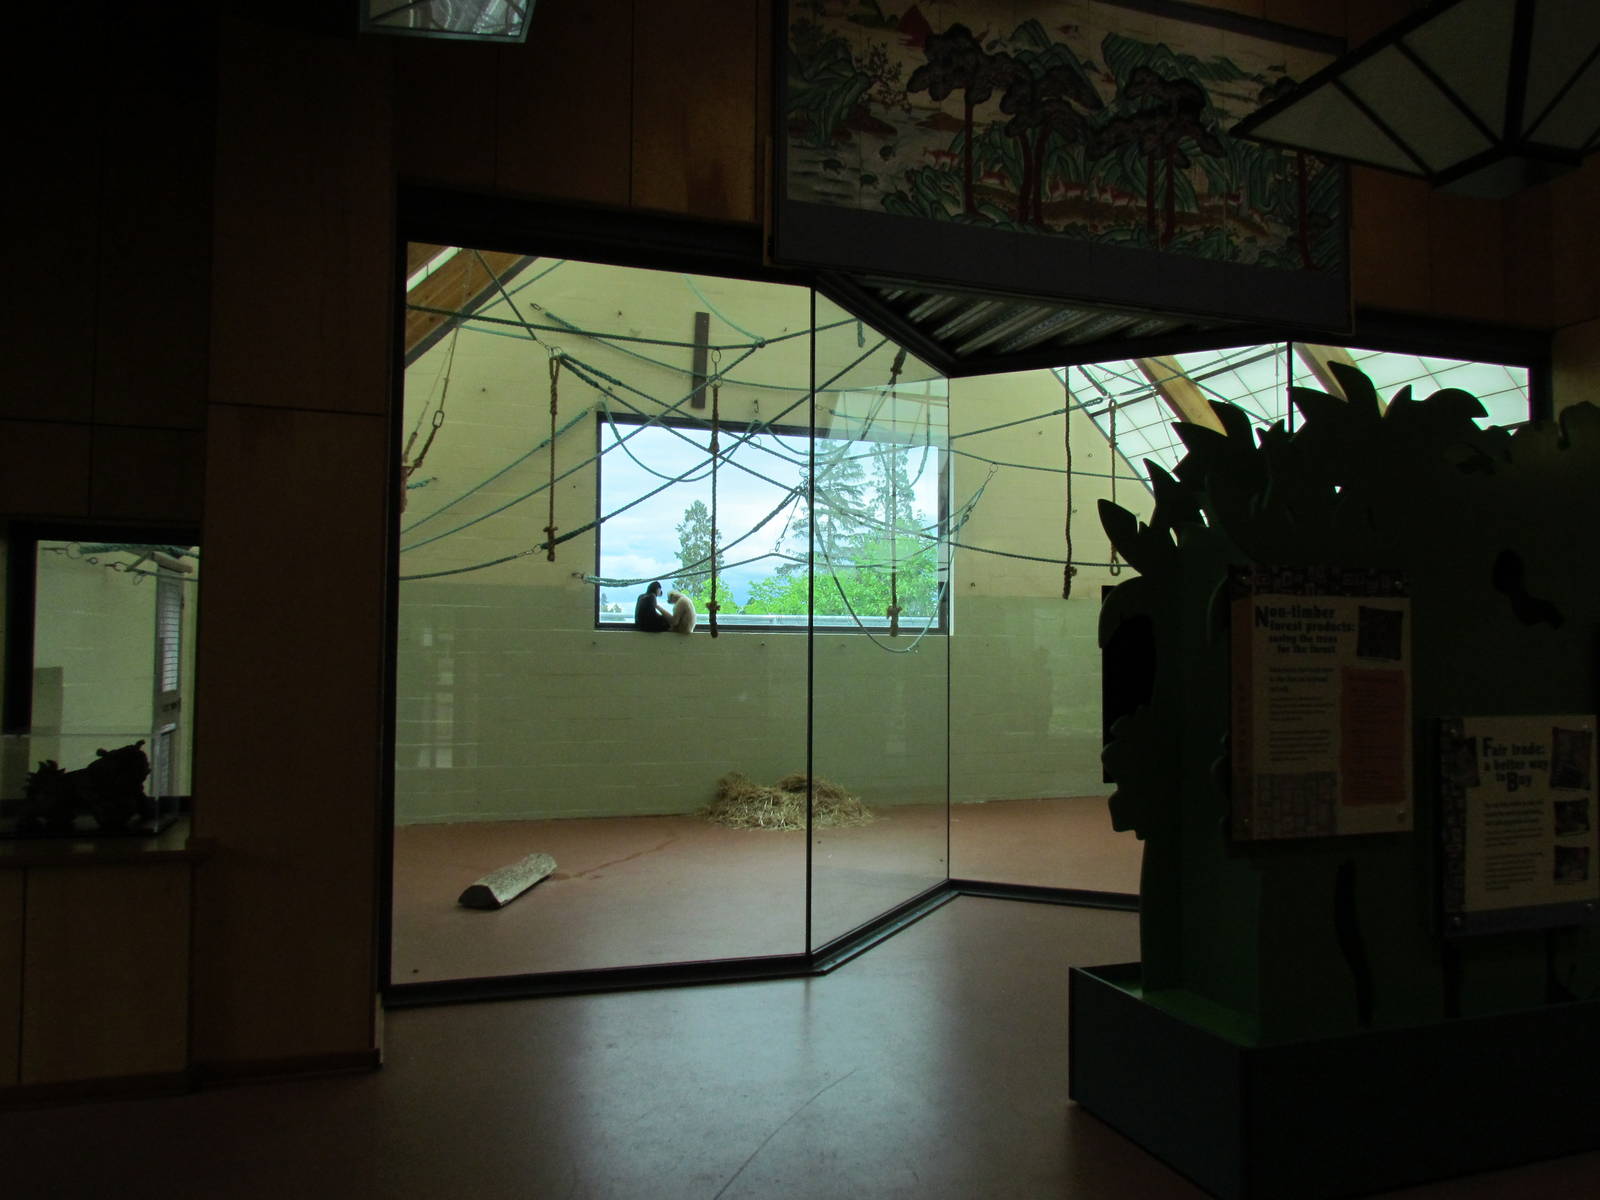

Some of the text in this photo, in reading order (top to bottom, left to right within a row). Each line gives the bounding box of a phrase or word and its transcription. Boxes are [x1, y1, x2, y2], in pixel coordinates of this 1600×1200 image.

[1255, 605, 1336, 628] Non-timber
[1270, 620, 1302, 631] forest
[1483, 737, 1508, 757] Fair
[1494, 759, 1525, 770] better
[1529, 760, 1548, 772] way
[1506, 772, 1532, 792] Buy
